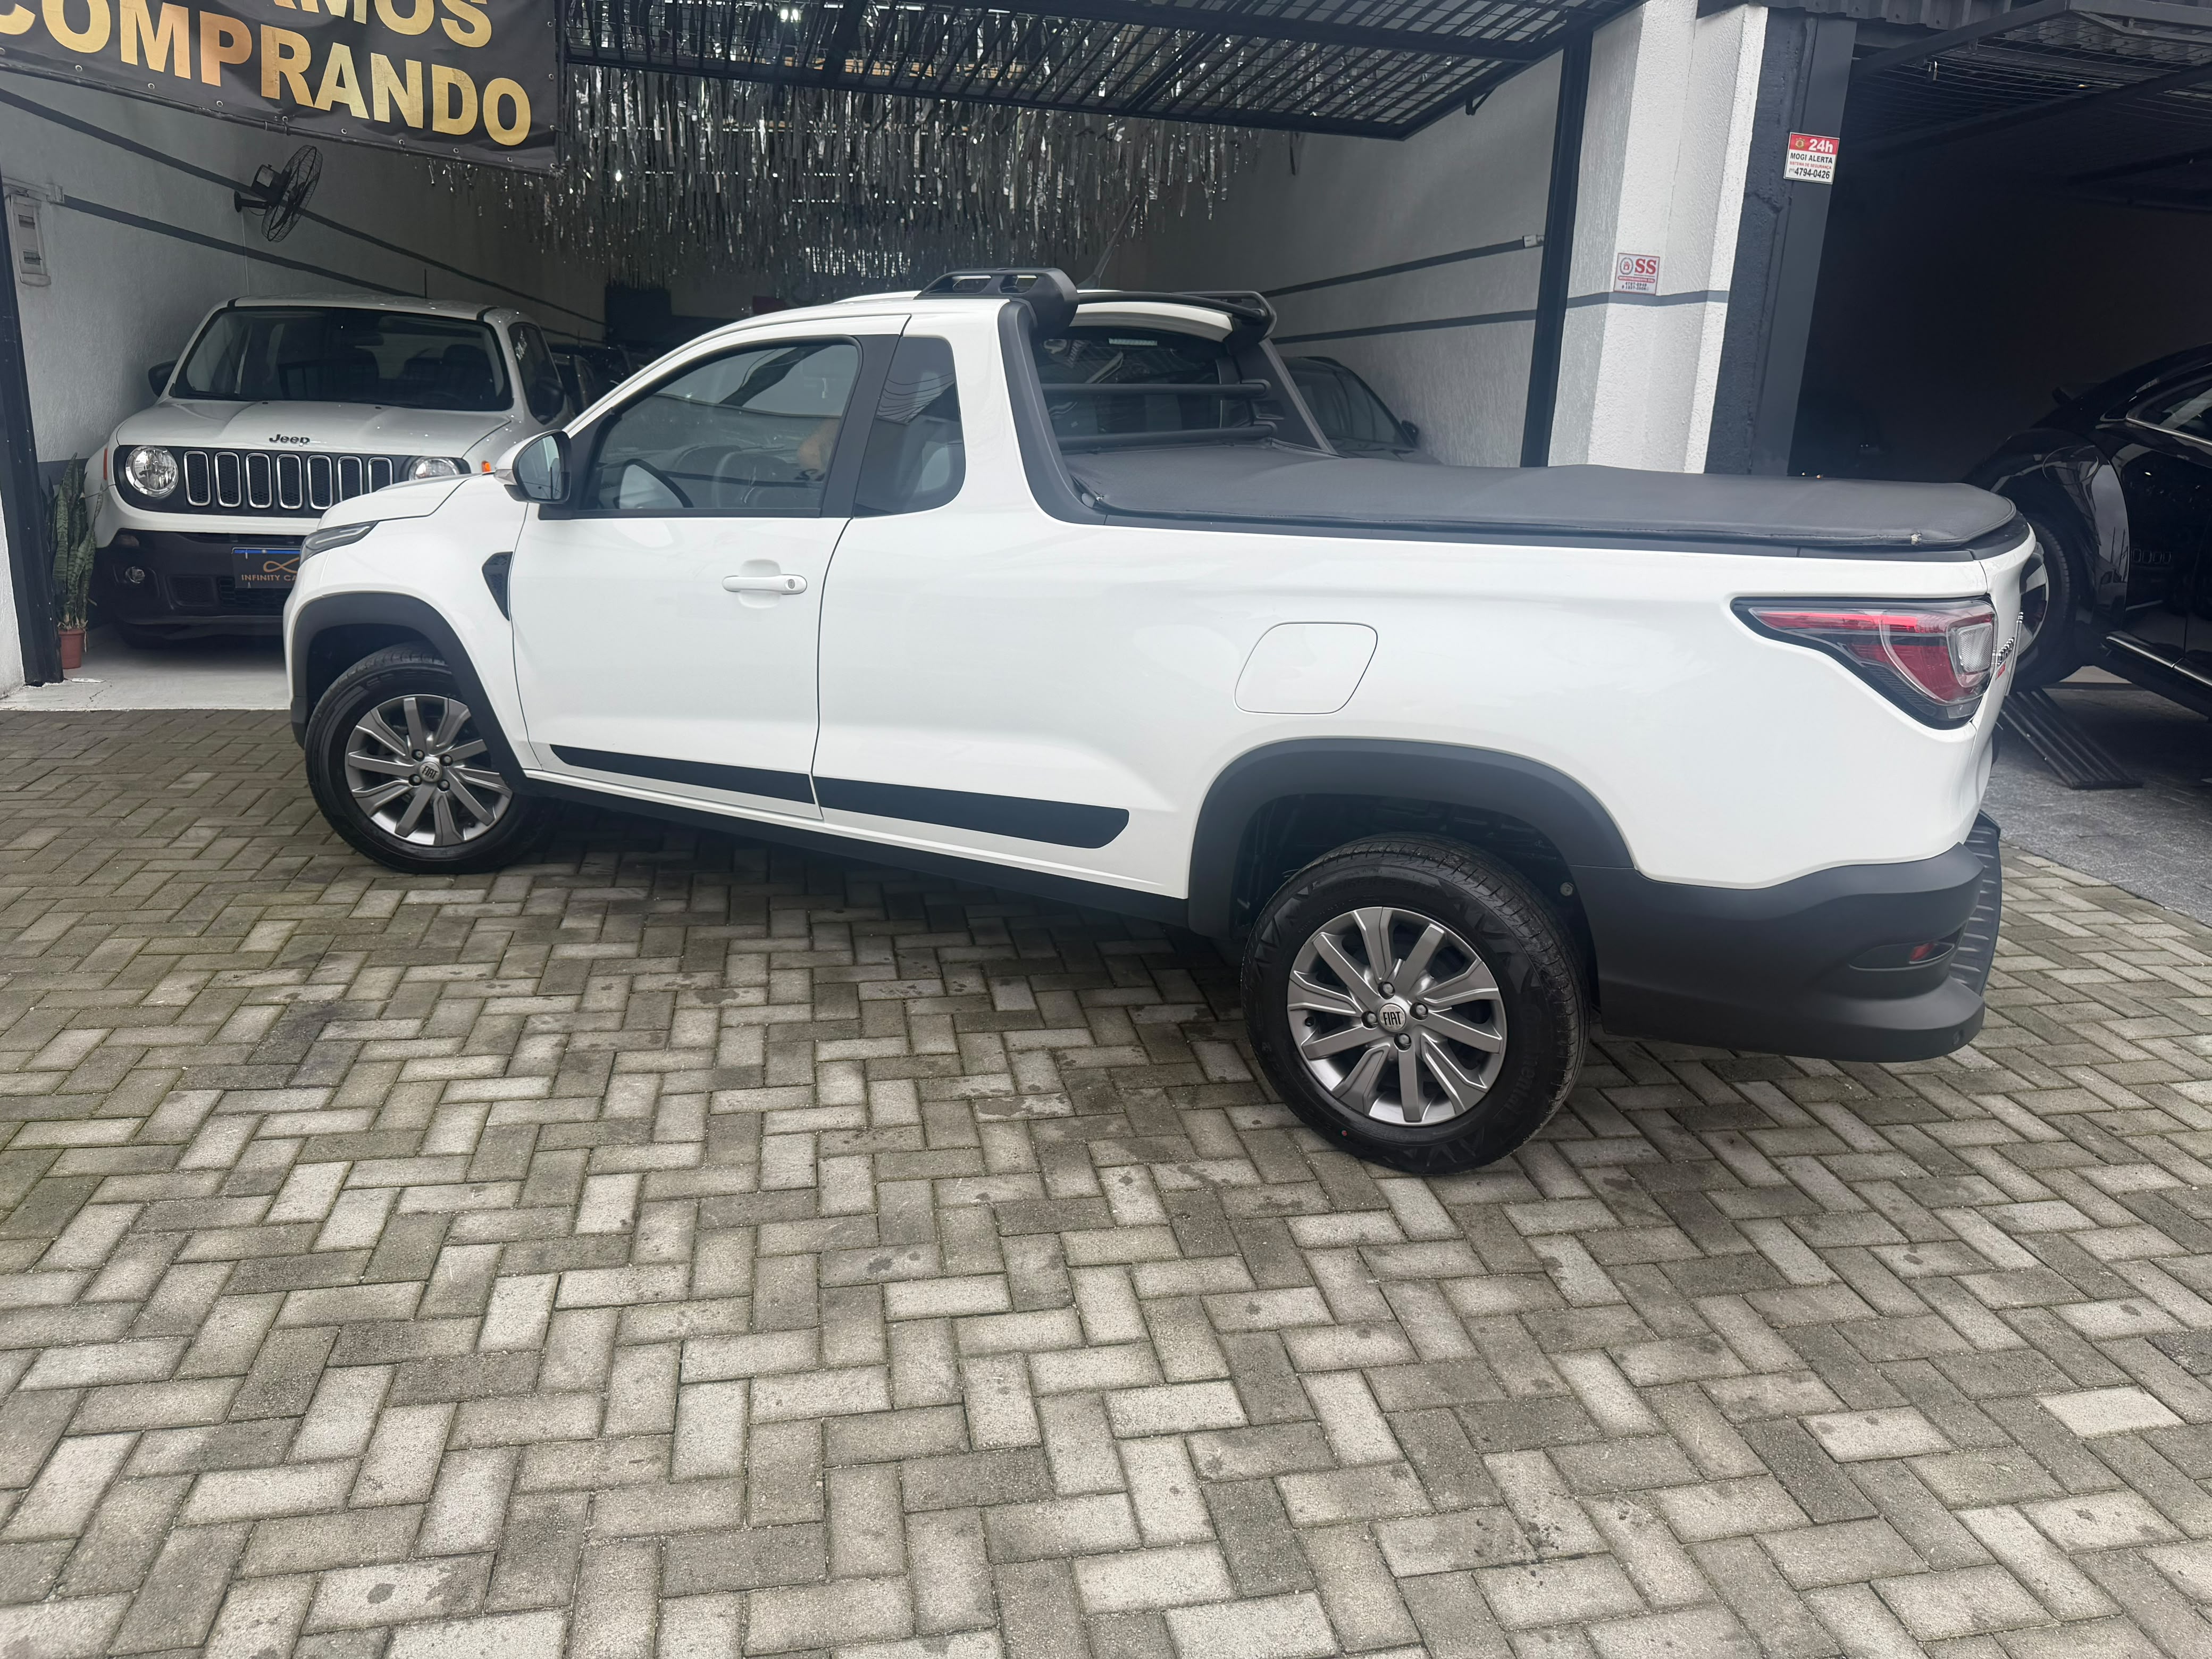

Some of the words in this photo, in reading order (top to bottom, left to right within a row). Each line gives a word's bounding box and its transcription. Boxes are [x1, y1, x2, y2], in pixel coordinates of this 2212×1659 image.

[274, 0, 492, 47] OS
[0, 0, 531, 146] OMPRANDO
[1808, 139, 1833, 153] 24h
[1790, 152, 1807, 161] MOGI
[1808, 155, 1833, 164] ALERTA
[1635, 258, 1656, 274] SS
[269, 434, 310, 447] Jeep
[422, 766, 439, 779] FIAT
[1382, 1011, 1402, 1026] FIAT
